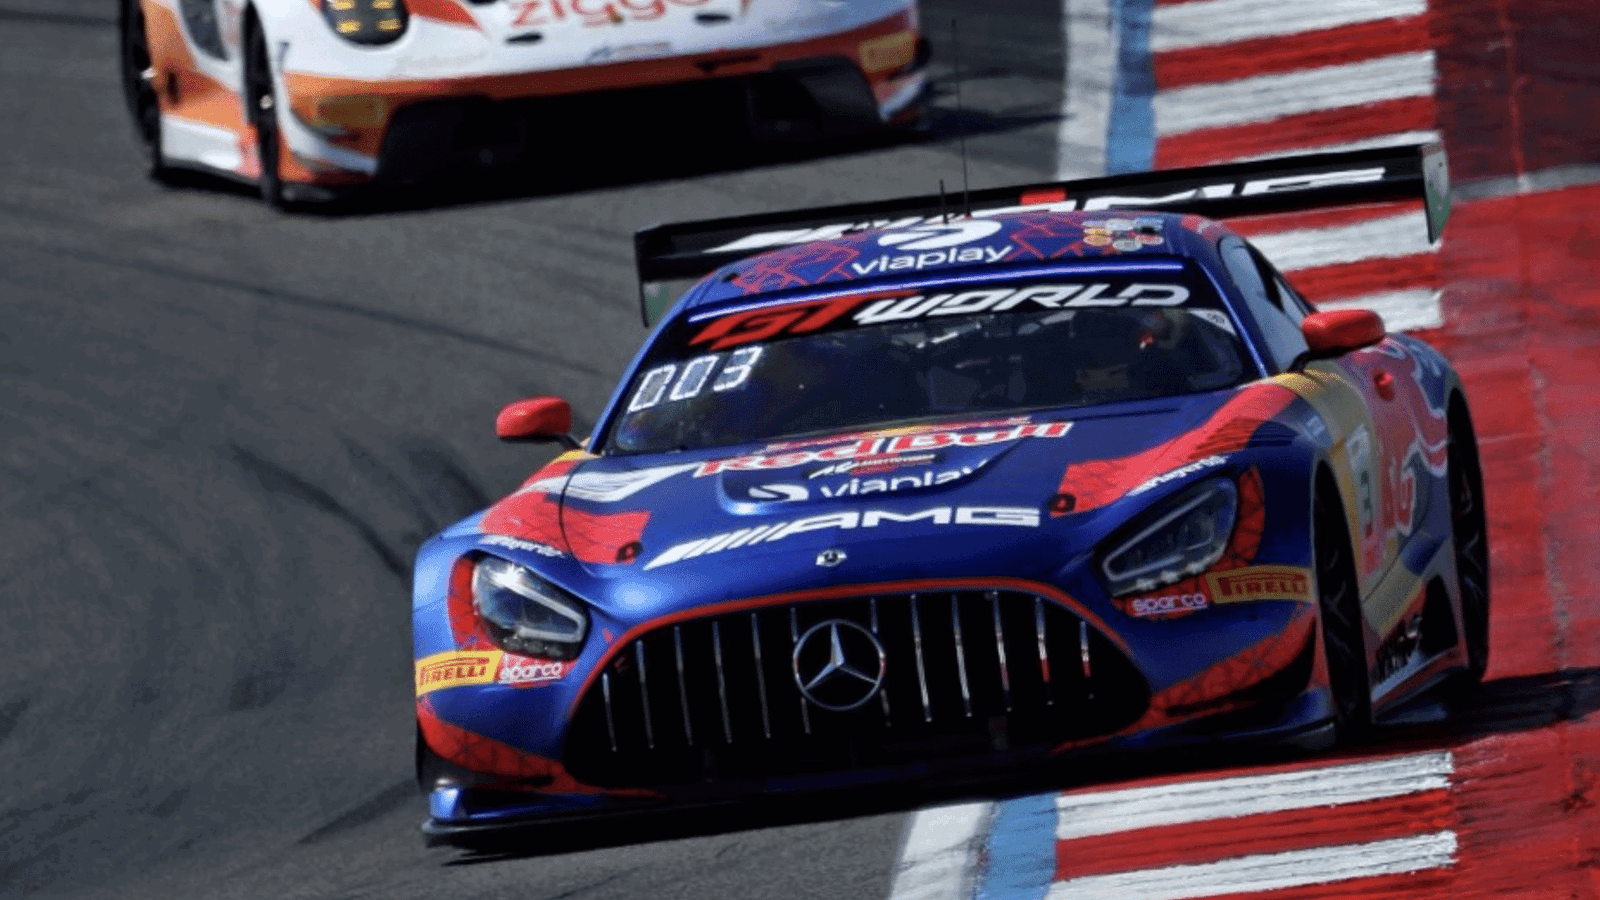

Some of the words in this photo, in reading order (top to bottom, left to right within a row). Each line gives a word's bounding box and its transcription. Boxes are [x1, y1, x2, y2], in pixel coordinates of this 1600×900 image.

[508, 0, 712, 29] zigg
[852, 245, 1013, 276] viaplay
[853, 283, 1190, 325] WORLD
[627, 345, 763, 413] 003
[1215, 572, 1310, 597] PIRELLI
[1131, 593, 1209, 616] sparco
[418, 657, 490, 687] PIRELLI
[499, 660, 562, 684] sparco
